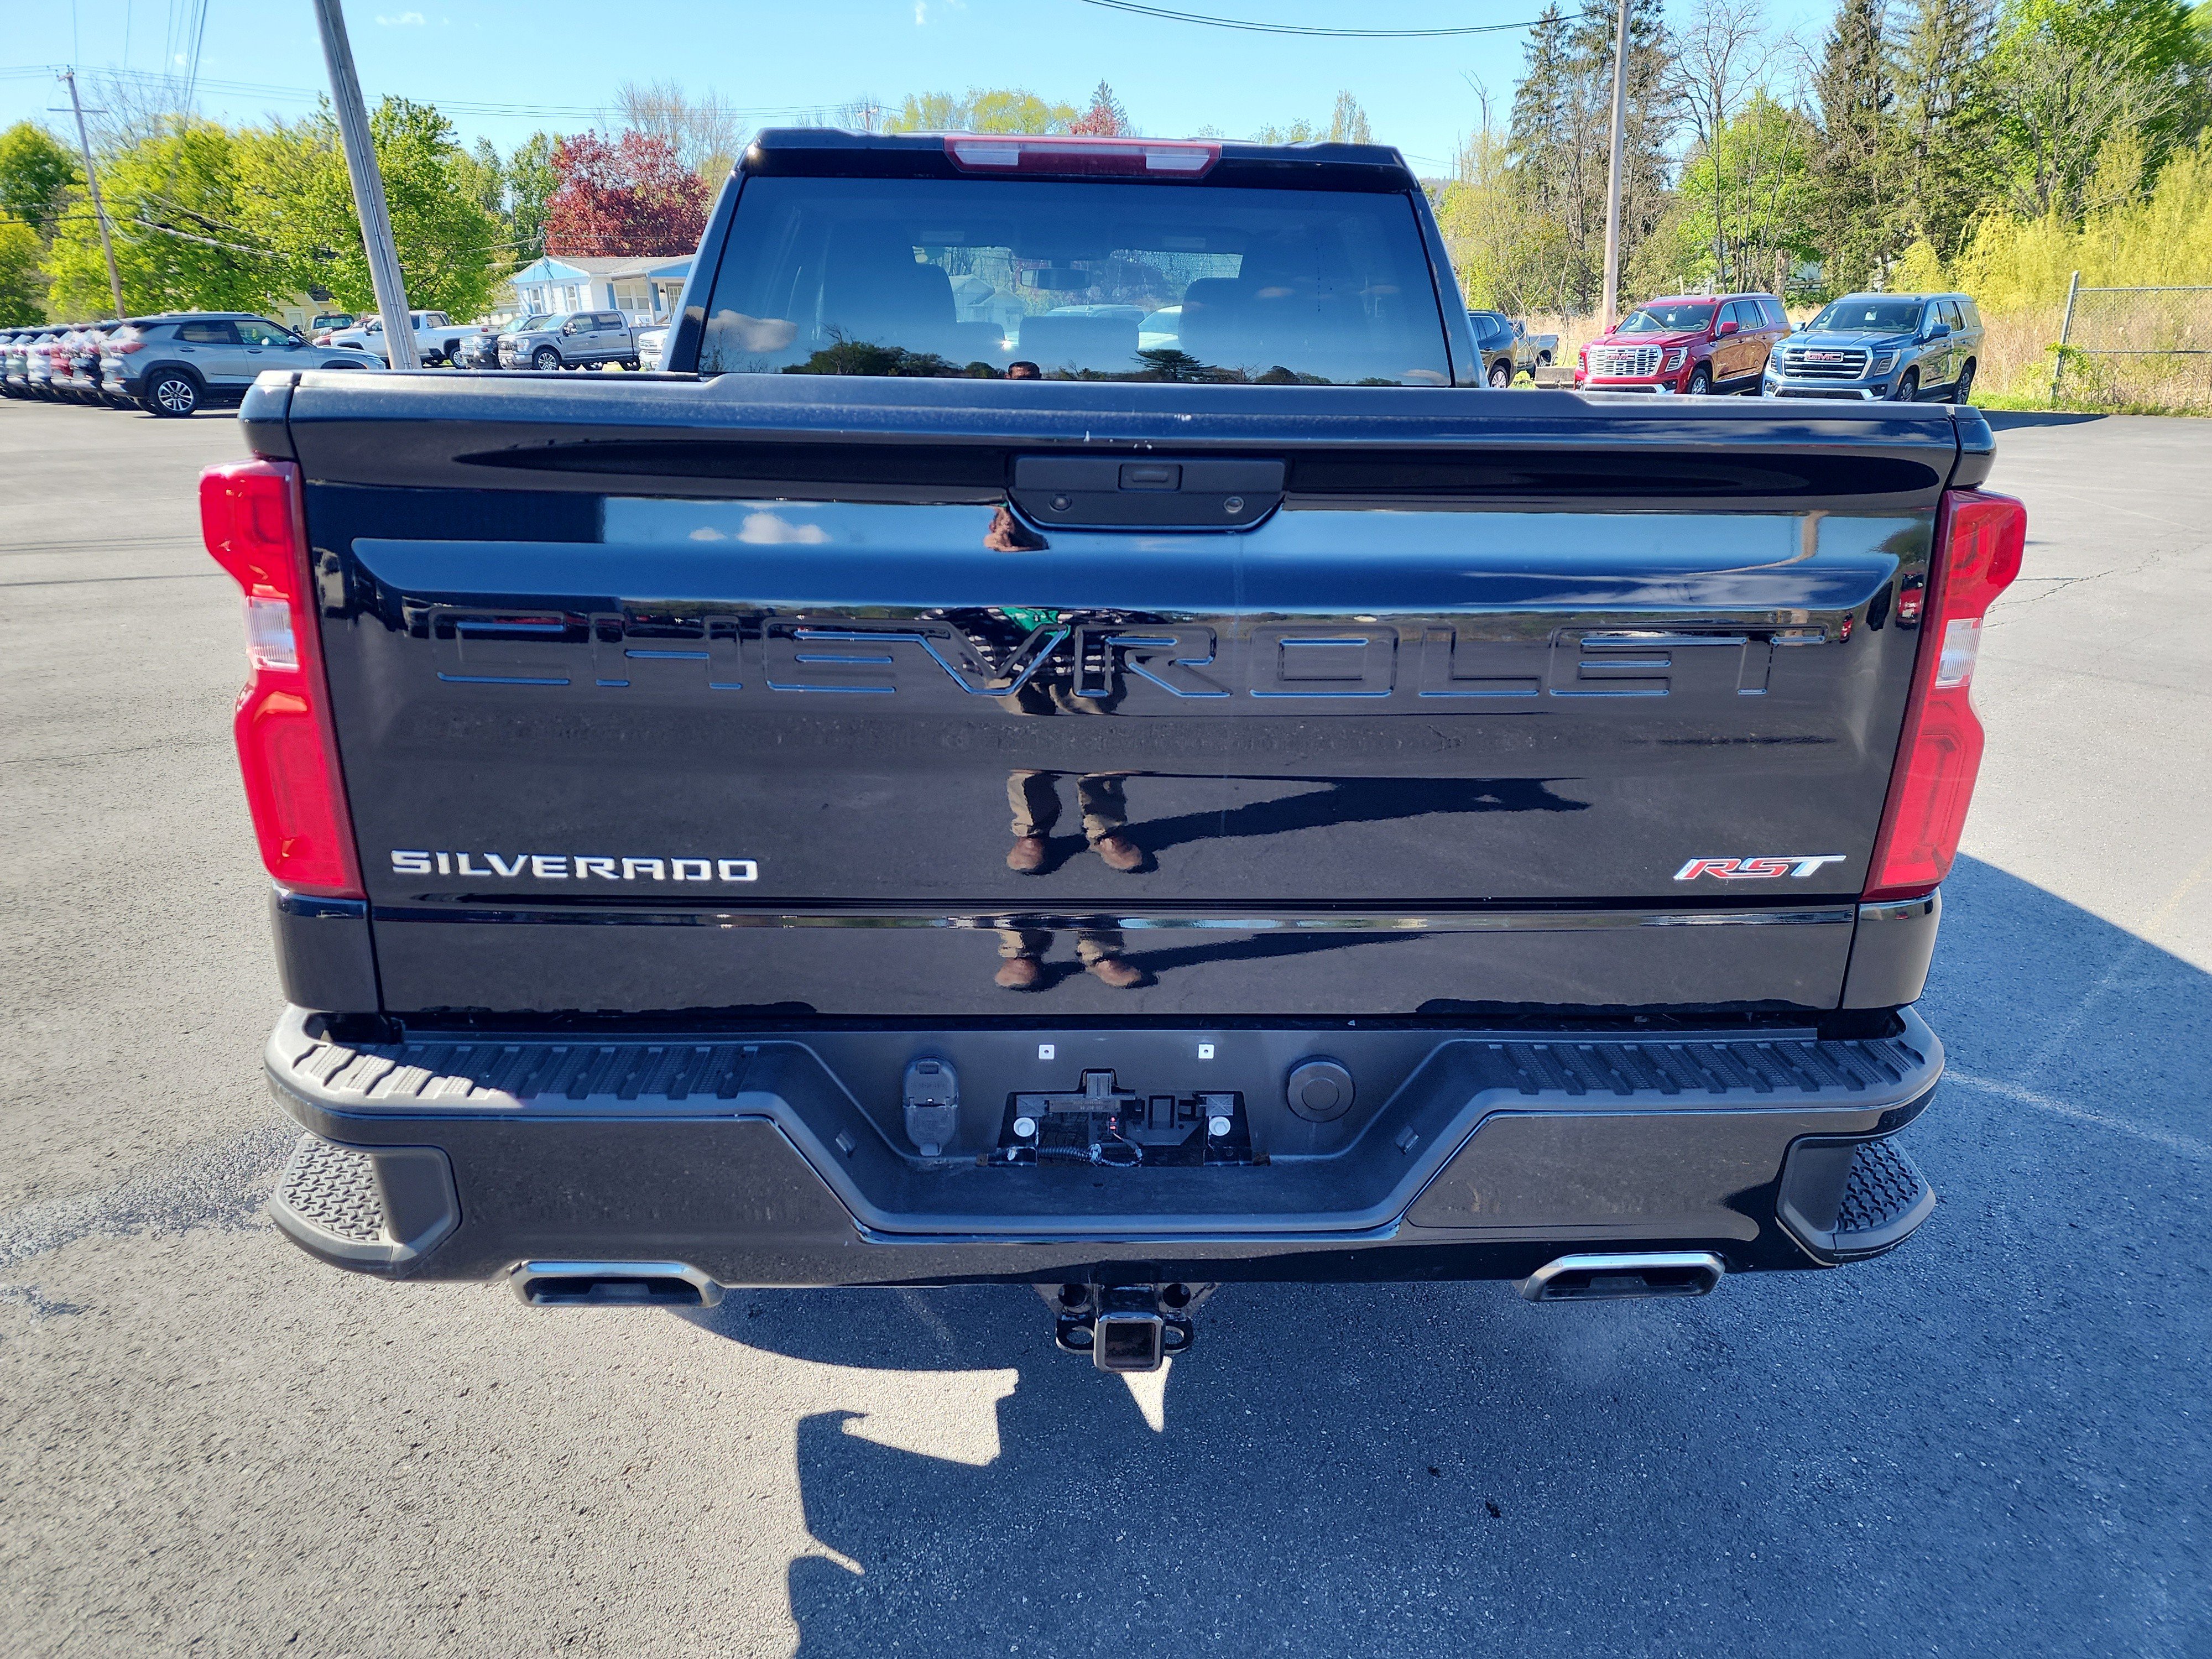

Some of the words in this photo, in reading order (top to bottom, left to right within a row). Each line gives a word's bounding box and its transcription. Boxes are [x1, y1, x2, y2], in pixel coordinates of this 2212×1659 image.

[1806, 352, 1841, 361] GMC
[428, 608, 1829, 699] CHEVROLET
[390, 851, 758, 881] SILVERADO
[1673, 855, 1847, 880] RST
